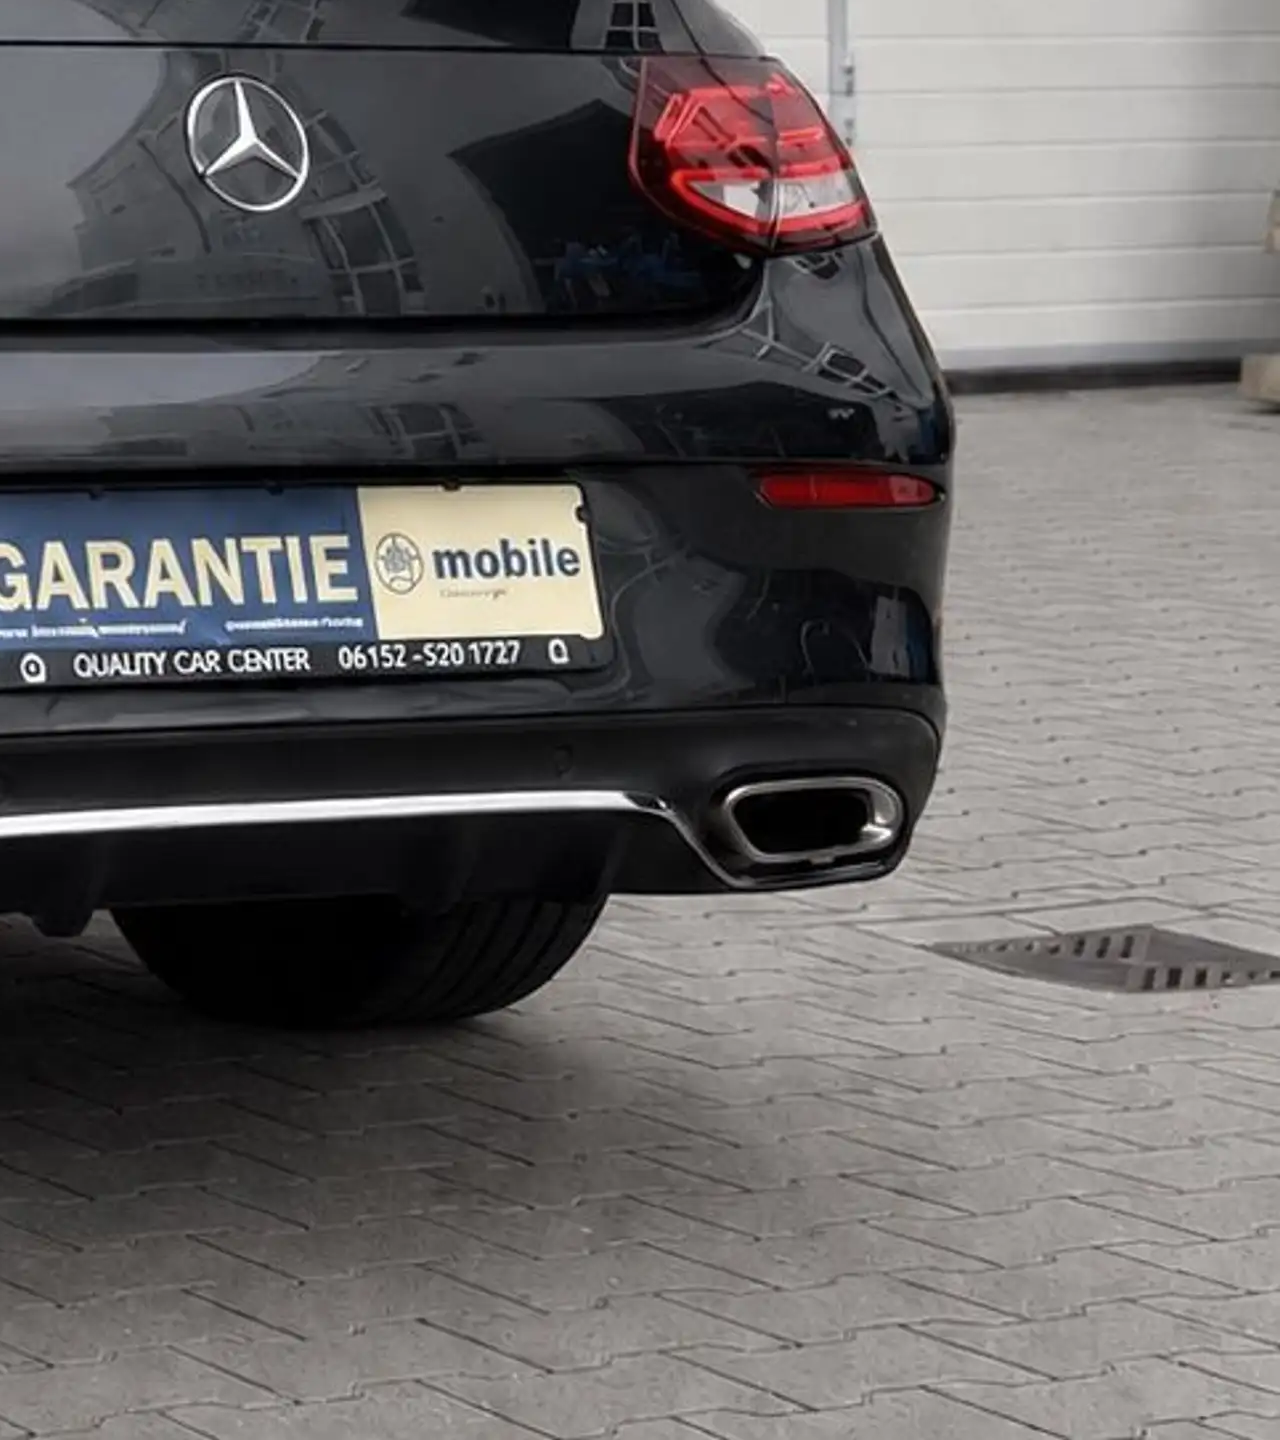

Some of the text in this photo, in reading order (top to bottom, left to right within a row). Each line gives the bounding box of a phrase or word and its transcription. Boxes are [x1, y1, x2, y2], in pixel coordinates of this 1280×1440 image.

[430, 537, 581, 580] mobile
[73, 652, 167, 678] QUALITY
[173, 649, 222, 673] CAR
[227, 645, 311, 672] CENTER
[338, 641, 407, 670] 06152
